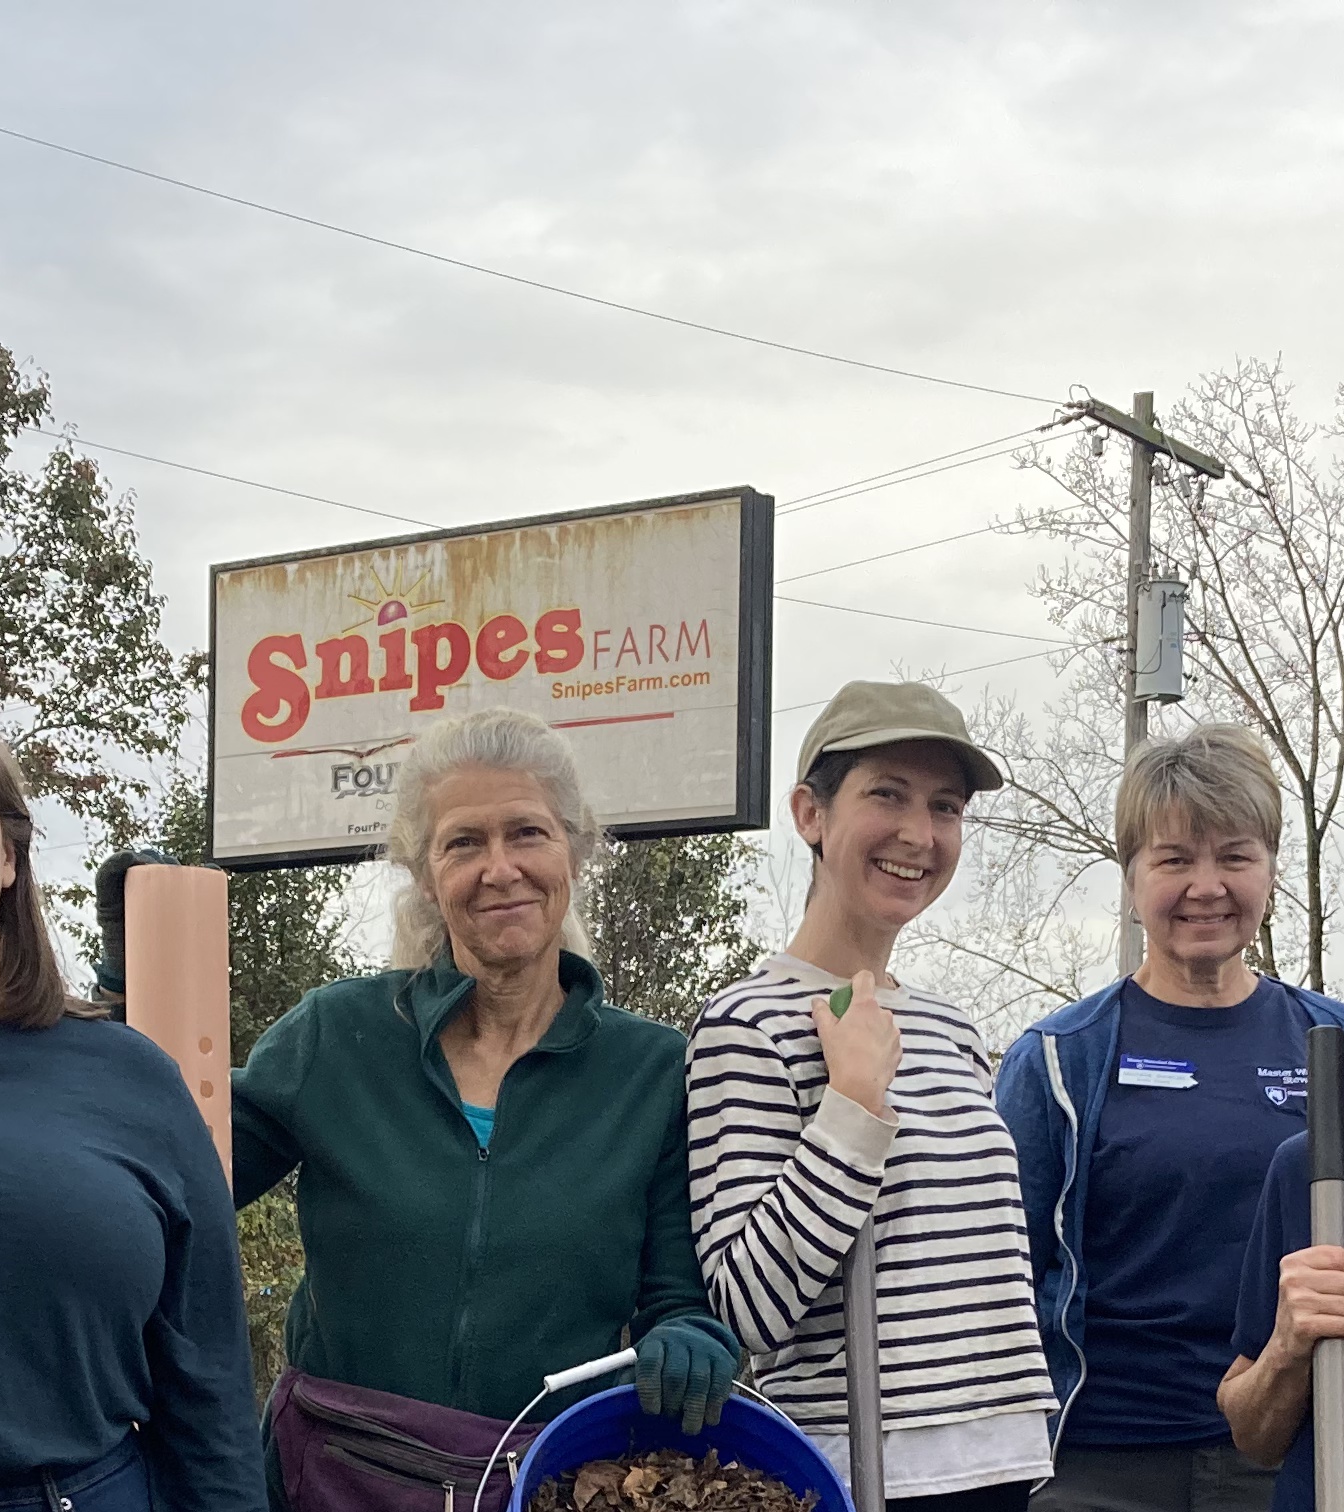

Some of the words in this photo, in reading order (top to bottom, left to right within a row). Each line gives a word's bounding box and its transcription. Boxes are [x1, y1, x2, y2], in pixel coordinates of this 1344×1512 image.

[241, 602, 585, 742] Snipes
[593, 619, 711, 670] FARM
[551, 671, 711, 701] SnipesFarm.com
[330, 762, 401, 793] FOU
[347, 822, 388, 835] FourPa
